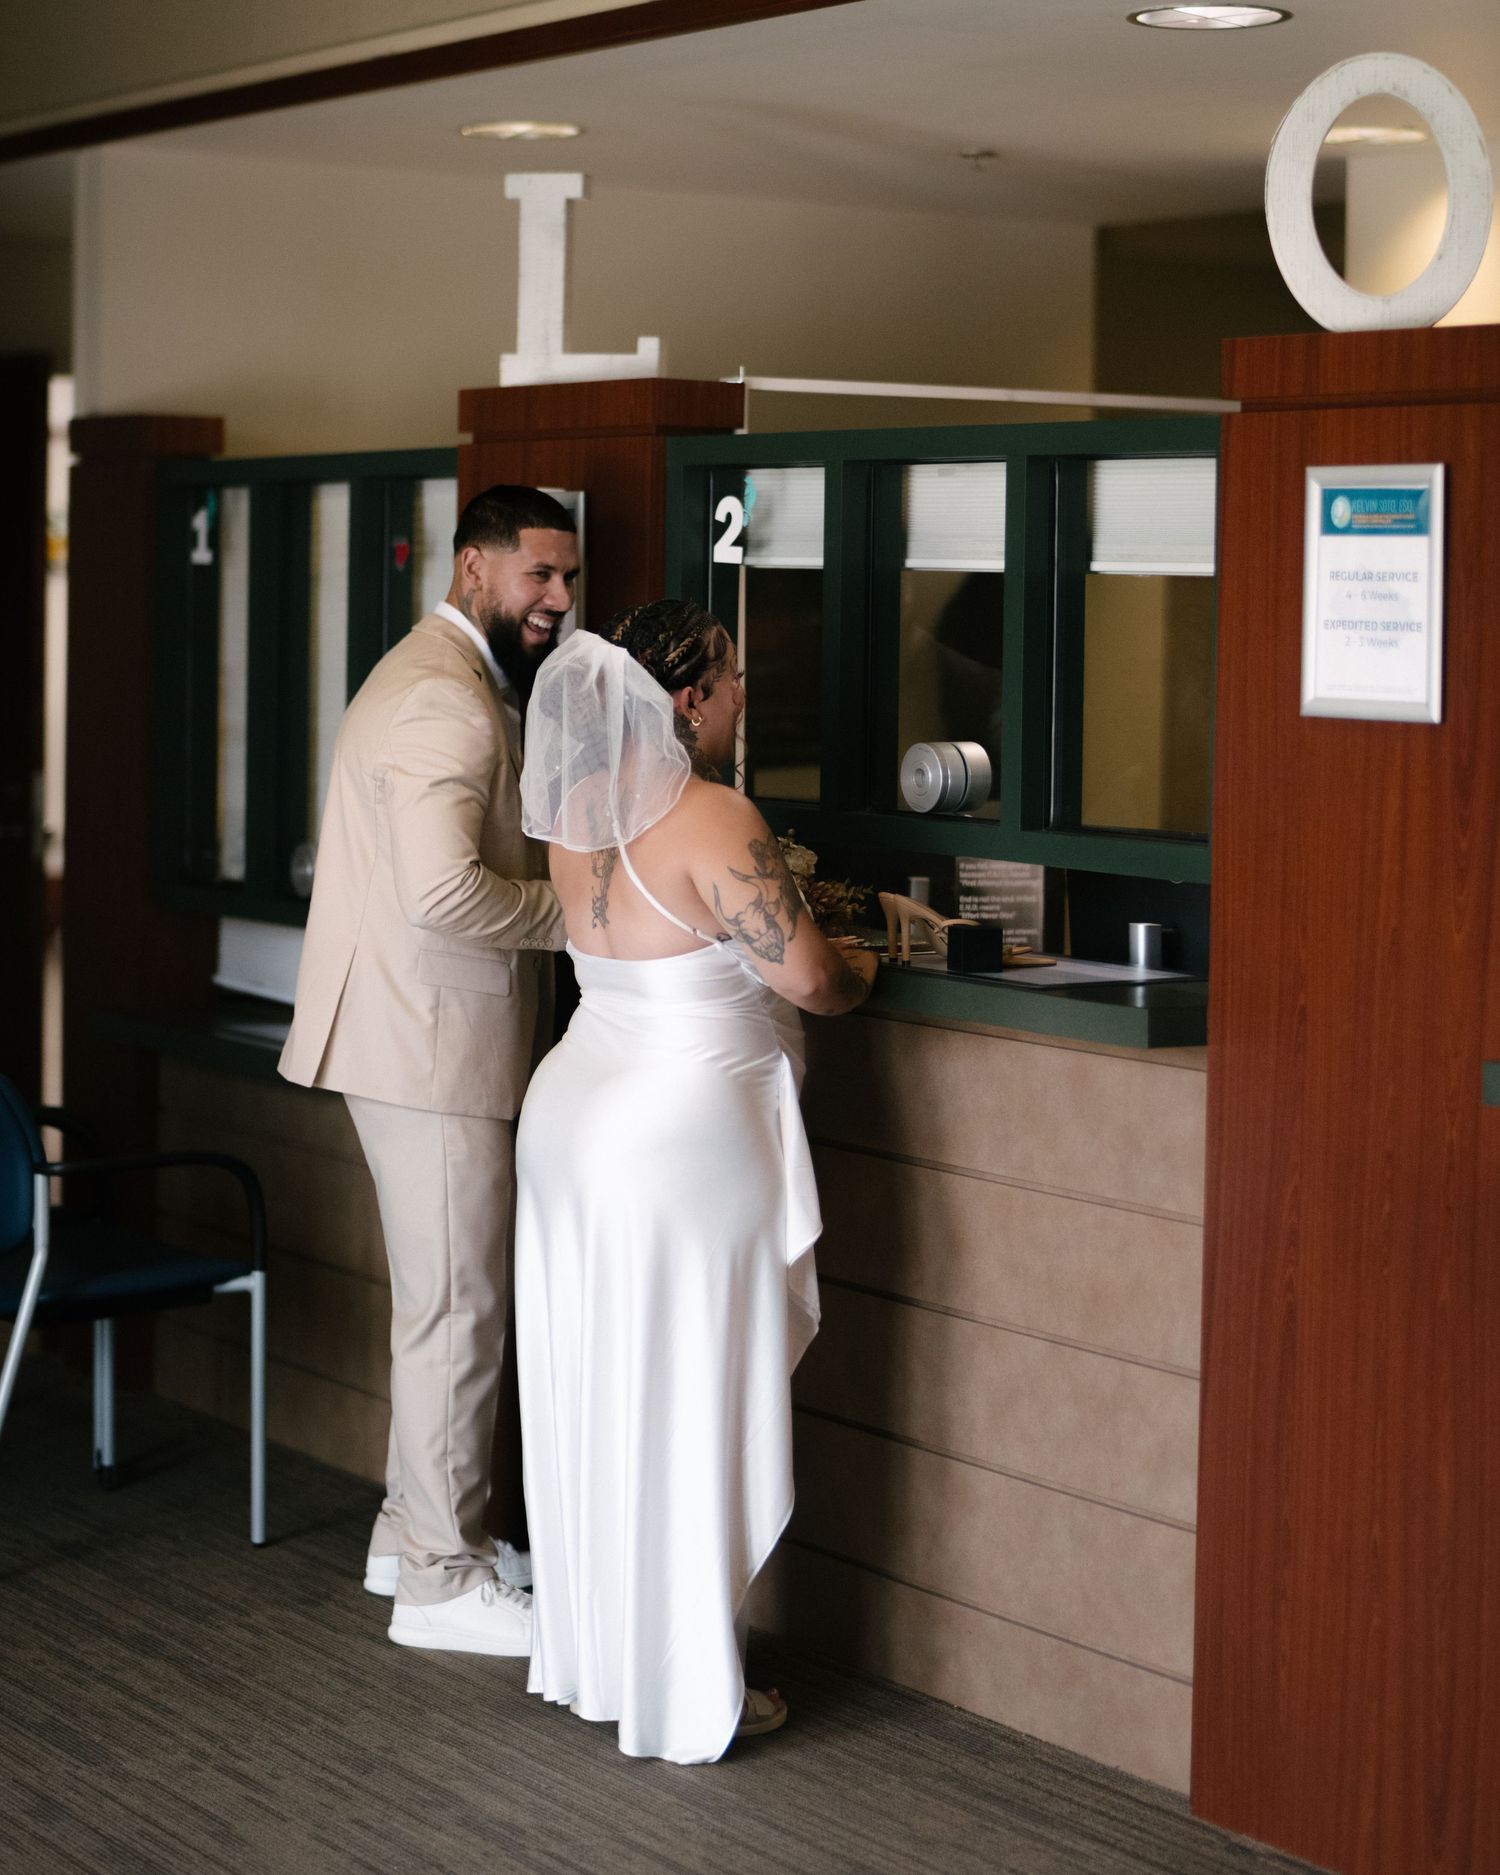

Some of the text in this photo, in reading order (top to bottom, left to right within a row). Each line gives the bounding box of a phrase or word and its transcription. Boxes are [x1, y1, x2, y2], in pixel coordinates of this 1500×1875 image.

[500, 172, 660, 388] L
[191, 508, 214, 565] 1
[713, 495, 743, 565] 2
[1329, 570, 1418, 583] REGULAR SERVICE
[1369, 591, 1399, 601] Weeks
[1323, 619, 1423, 632] EXPEDITED SERVICE
[1366, 636, 1399, 648] Weeks
